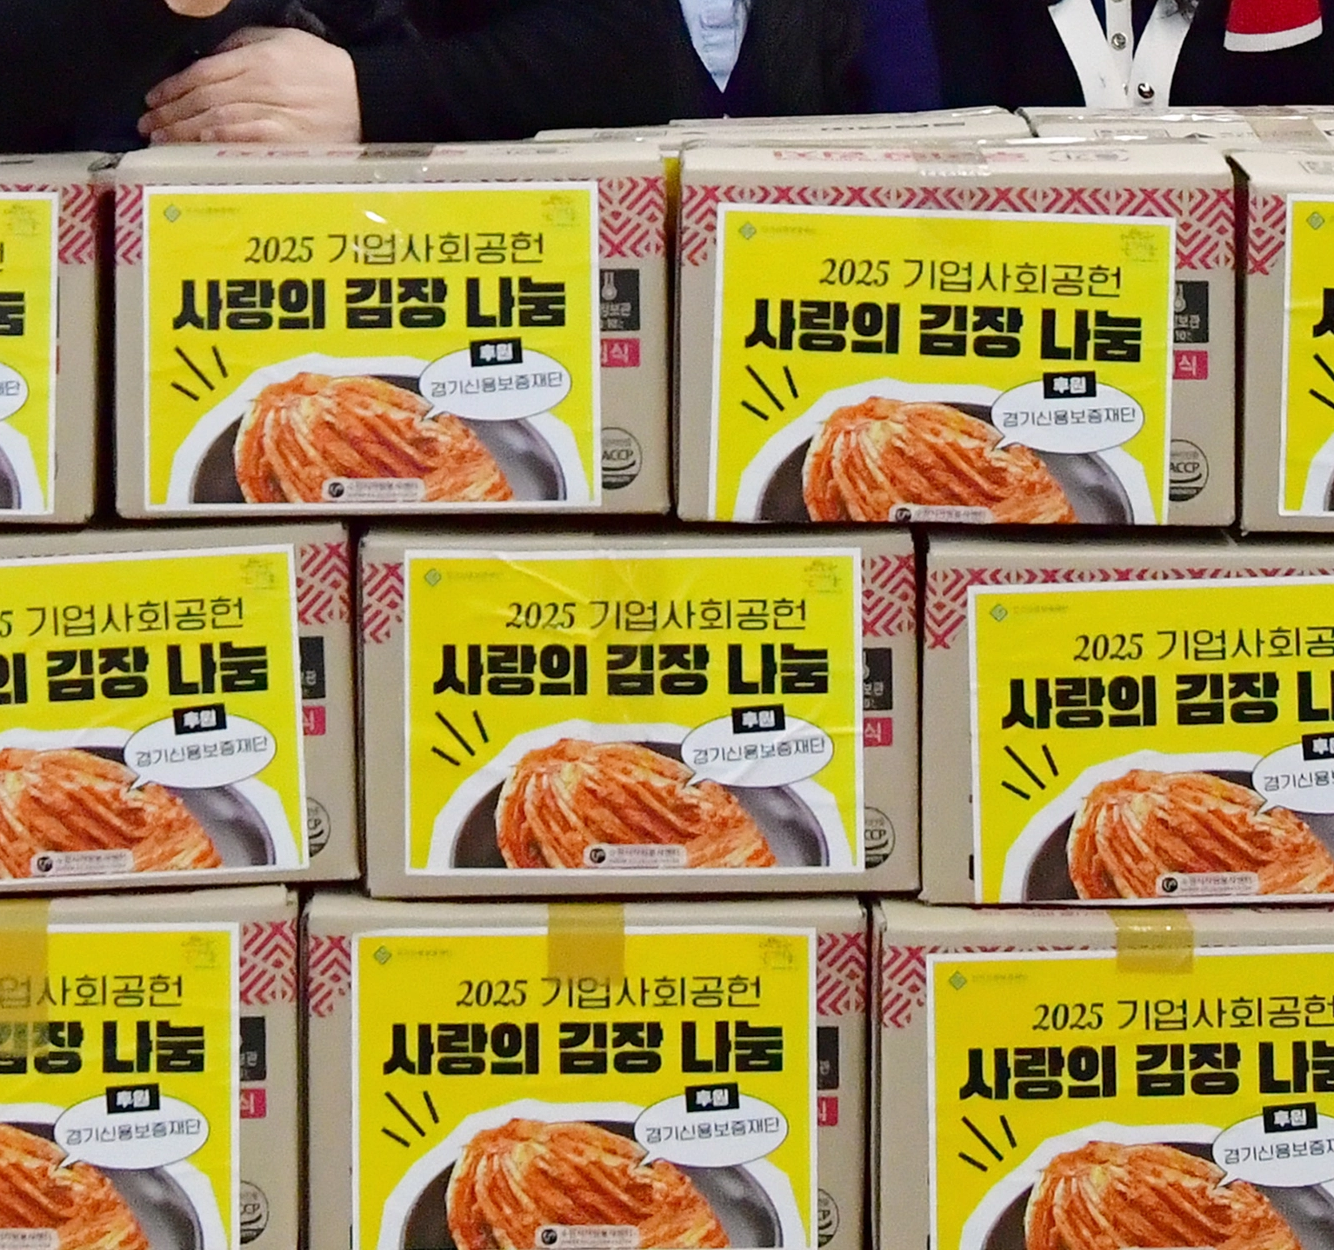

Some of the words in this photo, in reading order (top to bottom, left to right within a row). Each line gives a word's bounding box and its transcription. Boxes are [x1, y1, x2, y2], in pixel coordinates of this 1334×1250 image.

[244, 237, 314, 264] 2025
[327, 231, 543, 265] 기업사회공헌
[819, 258, 890, 287] 2025
[904, 259, 1121, 297] 기업사회공헌
[172, 278, 326, 331] 사랑의
[345, 277, 448, 330] 김장
[465, 276, 566, 328] 나눔
[743, 298, 901, 355] 사랑의
[919, 304, 1024, 359] 김장
[1040, 308, 1142, 363] 나눔
[480, 344, 513, 361] 후원
[431, 372, 562, 397] 경기신용보증재단
[1053, 377, 1086, 393] 후원
[1003, 407, 1135, 428] 경기신용보증재단
[601, 450, 633, 462] ACCP
[26, 596, 243, 637] 기업사회공헌
[505, 602, 575, 629] 2025
[589, 597, 805, 632] 기업사회공헌
[1073, 634, 1143, 662] 2025
[46, 646, 149, 703] 김장
[167, 641, 269, 696] 나눔
[432, 644, 588, 696] 사랑의
[607, 643, 710, 696] 김장
[727, 643, 828, 695] 나눔
[1001, 675, 1157, 730] 사랑의
[1176, 672, 1280, 726] 김장
[184, 710, 216, 728] 후원
[742, 711, 775, 728] 후원
[136, 736, 267, 767] 경기신용보증재단
[693, 739, 825, 764] 경기신용보증재단
[456, 980, 527, 1008] 2025
[541, 974, 760, 1009] 기업사회공헌
[1032, 1003, 1103, 1031] 2025
[102, 1020, 205, 1074] 나눔
[382, 1022, 540, 1076] 사랑의
[559, 1021, 664, 1075] 김장
[681, 1020, 783, 1073] 나눔
[958, 1045, 1117, 1100] 사랑의
[1136, 1042, 1241, 1097] 김장
[117, 1090, 150, 1108] 후원
[696, 1089, 729, 1106] 후원
[66, 1119, 200, 1145] 경기신용보증재단
[646, 1117, 779, 1143] 경기신용보증재단
[1274, 1109, 1307, 1127] 후원
